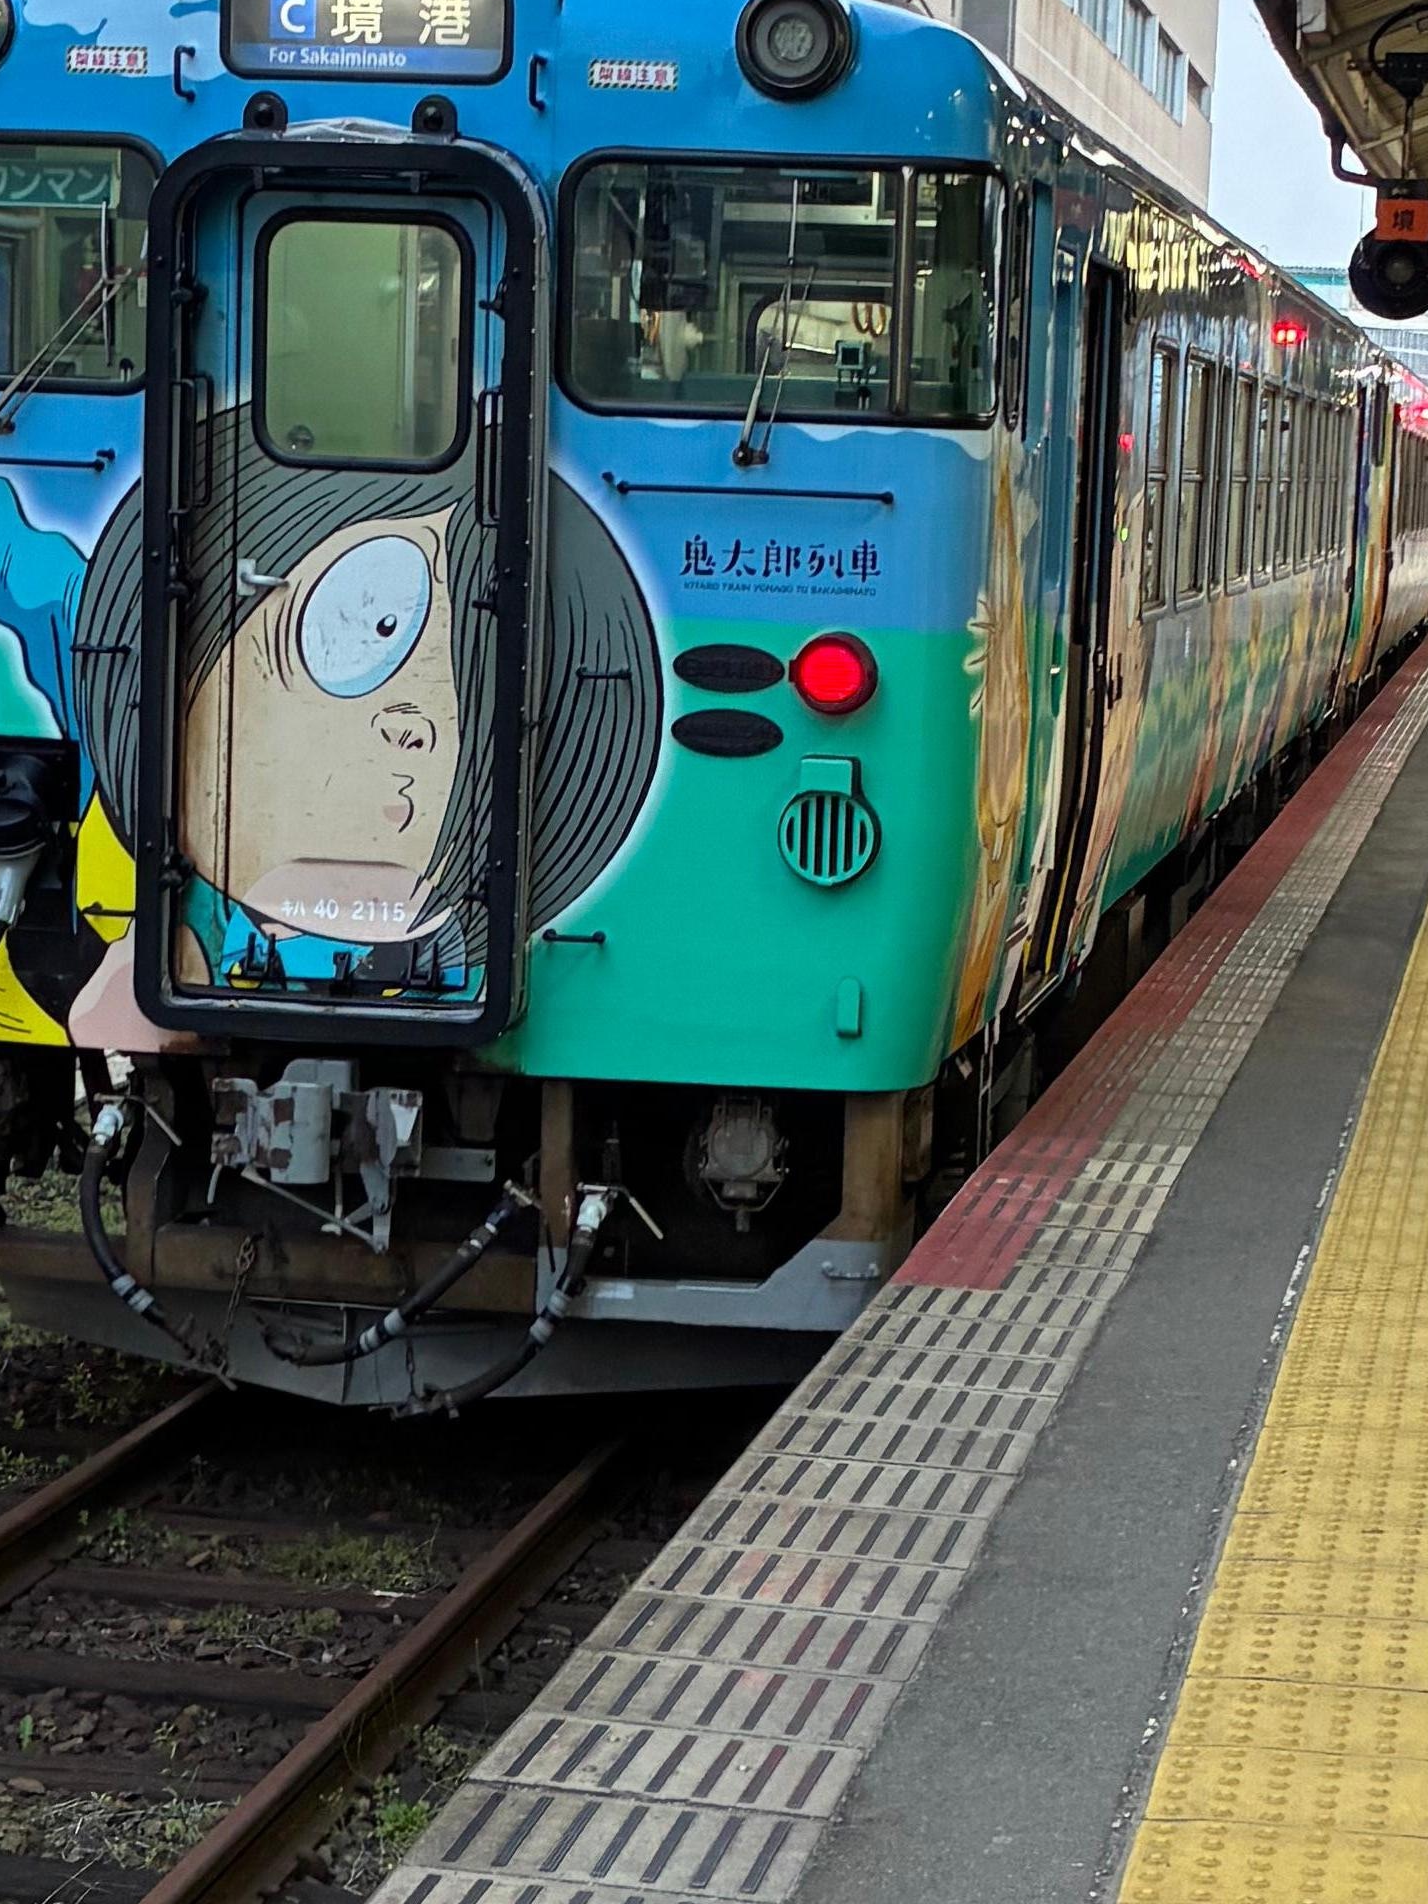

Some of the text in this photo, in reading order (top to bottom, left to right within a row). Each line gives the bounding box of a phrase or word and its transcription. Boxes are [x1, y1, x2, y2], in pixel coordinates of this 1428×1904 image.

[269, 47, 407, 68] For Sakaiminato
[679, 533, 882, 584] 鬼太郎列車
[313, 898, 340, 920] 40
[351, 899, 406, 923] 2115
